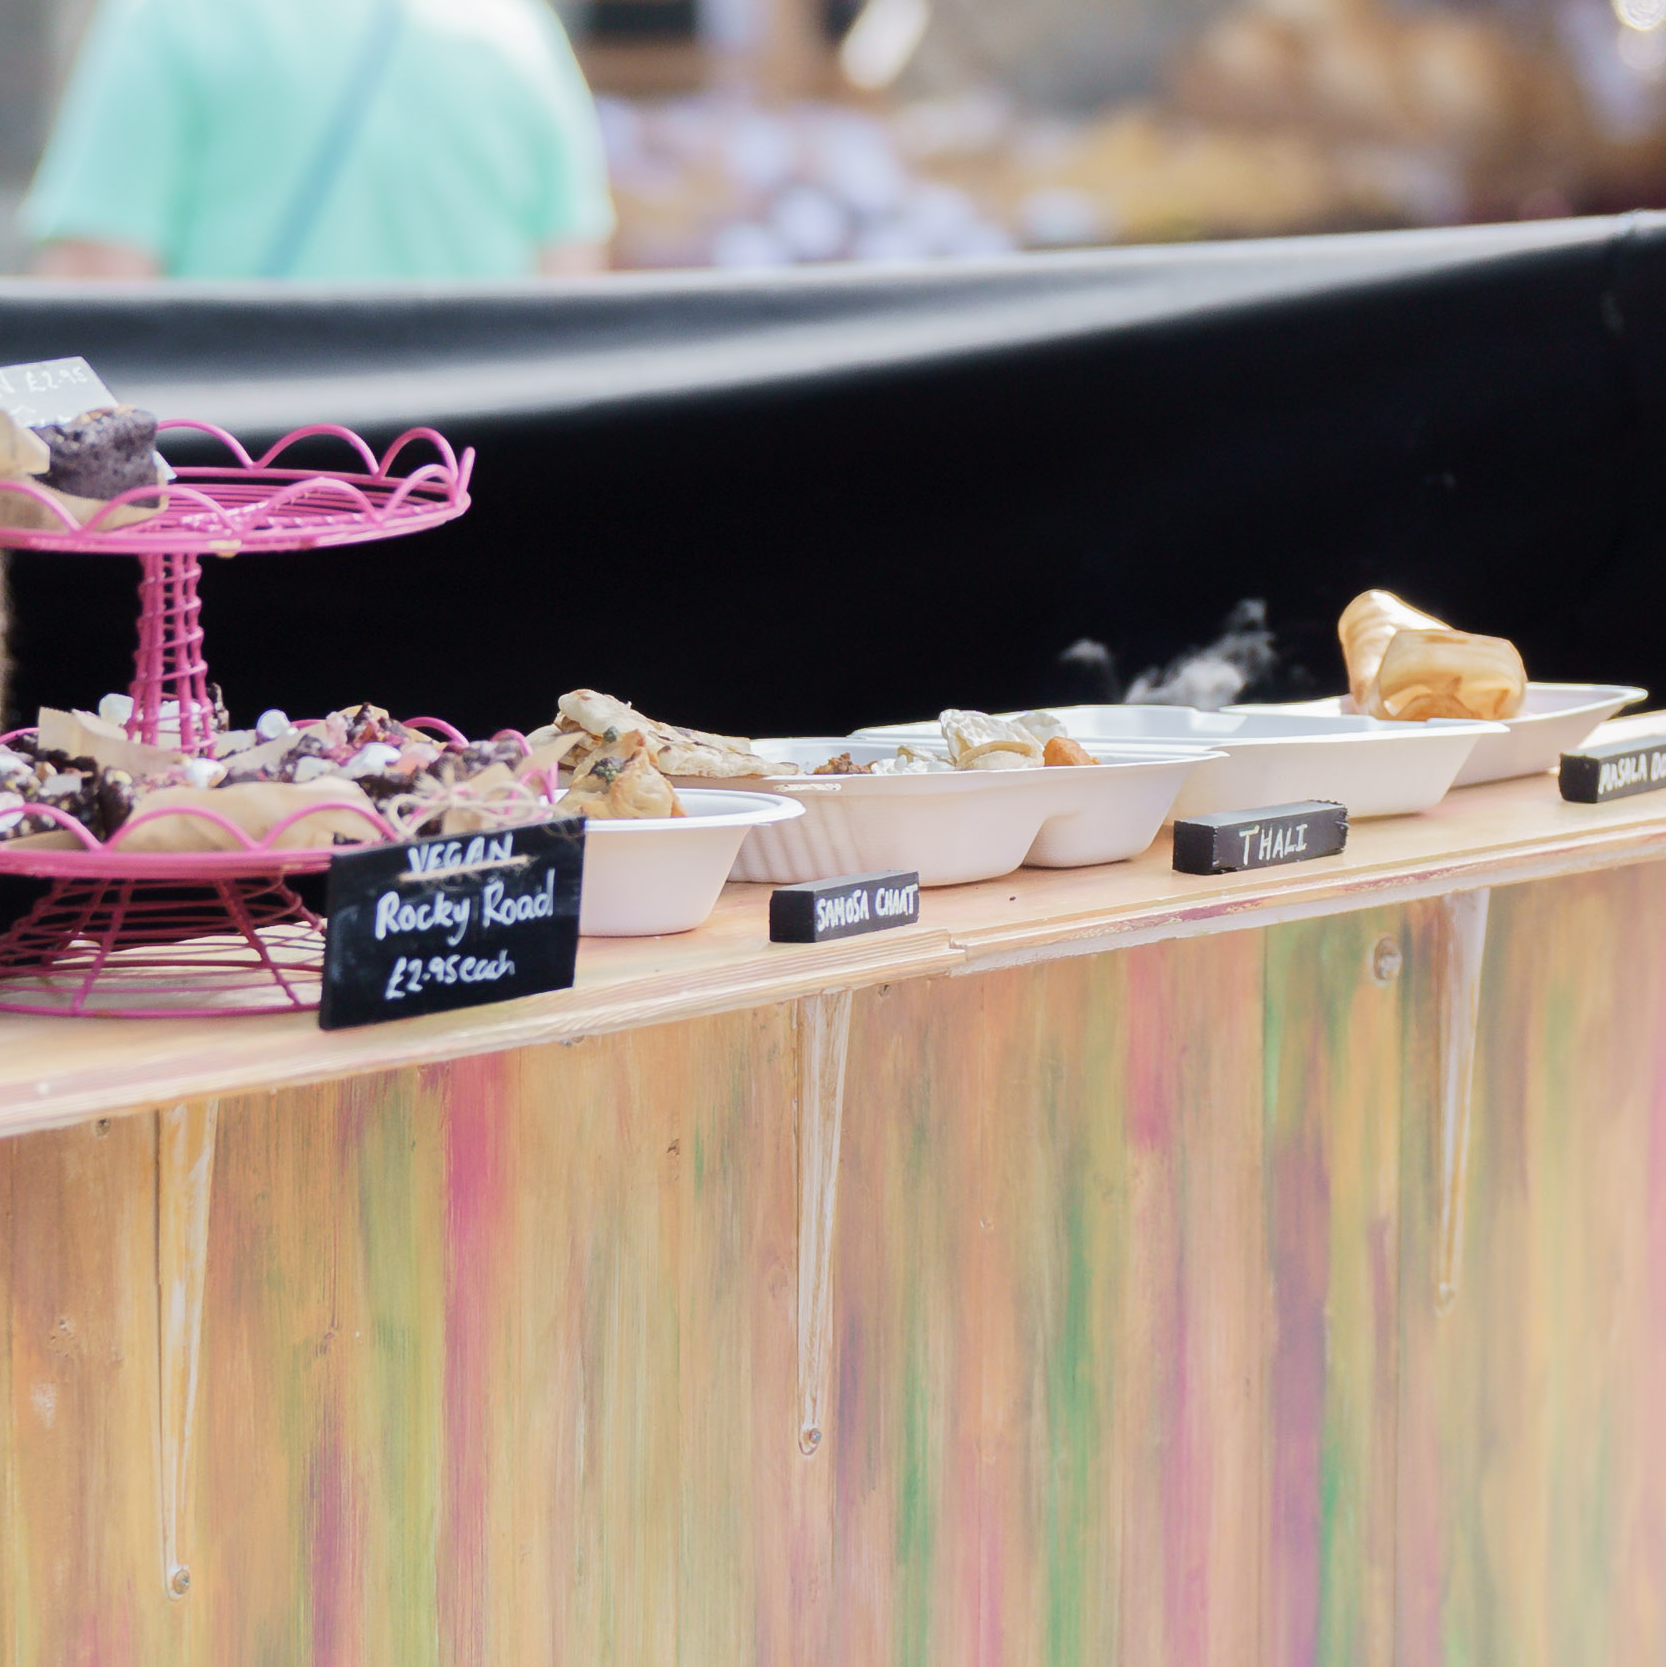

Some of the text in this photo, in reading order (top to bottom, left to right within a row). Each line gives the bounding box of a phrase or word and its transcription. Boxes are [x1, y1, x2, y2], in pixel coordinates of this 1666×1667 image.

[407, 832, 514, 875] VEGAN
[1239, 822, 1309, 866] THALI
[375, 867, 557, 947] Rocky Road
[815, 883, 919, 933] SAMOSA CHAAT
